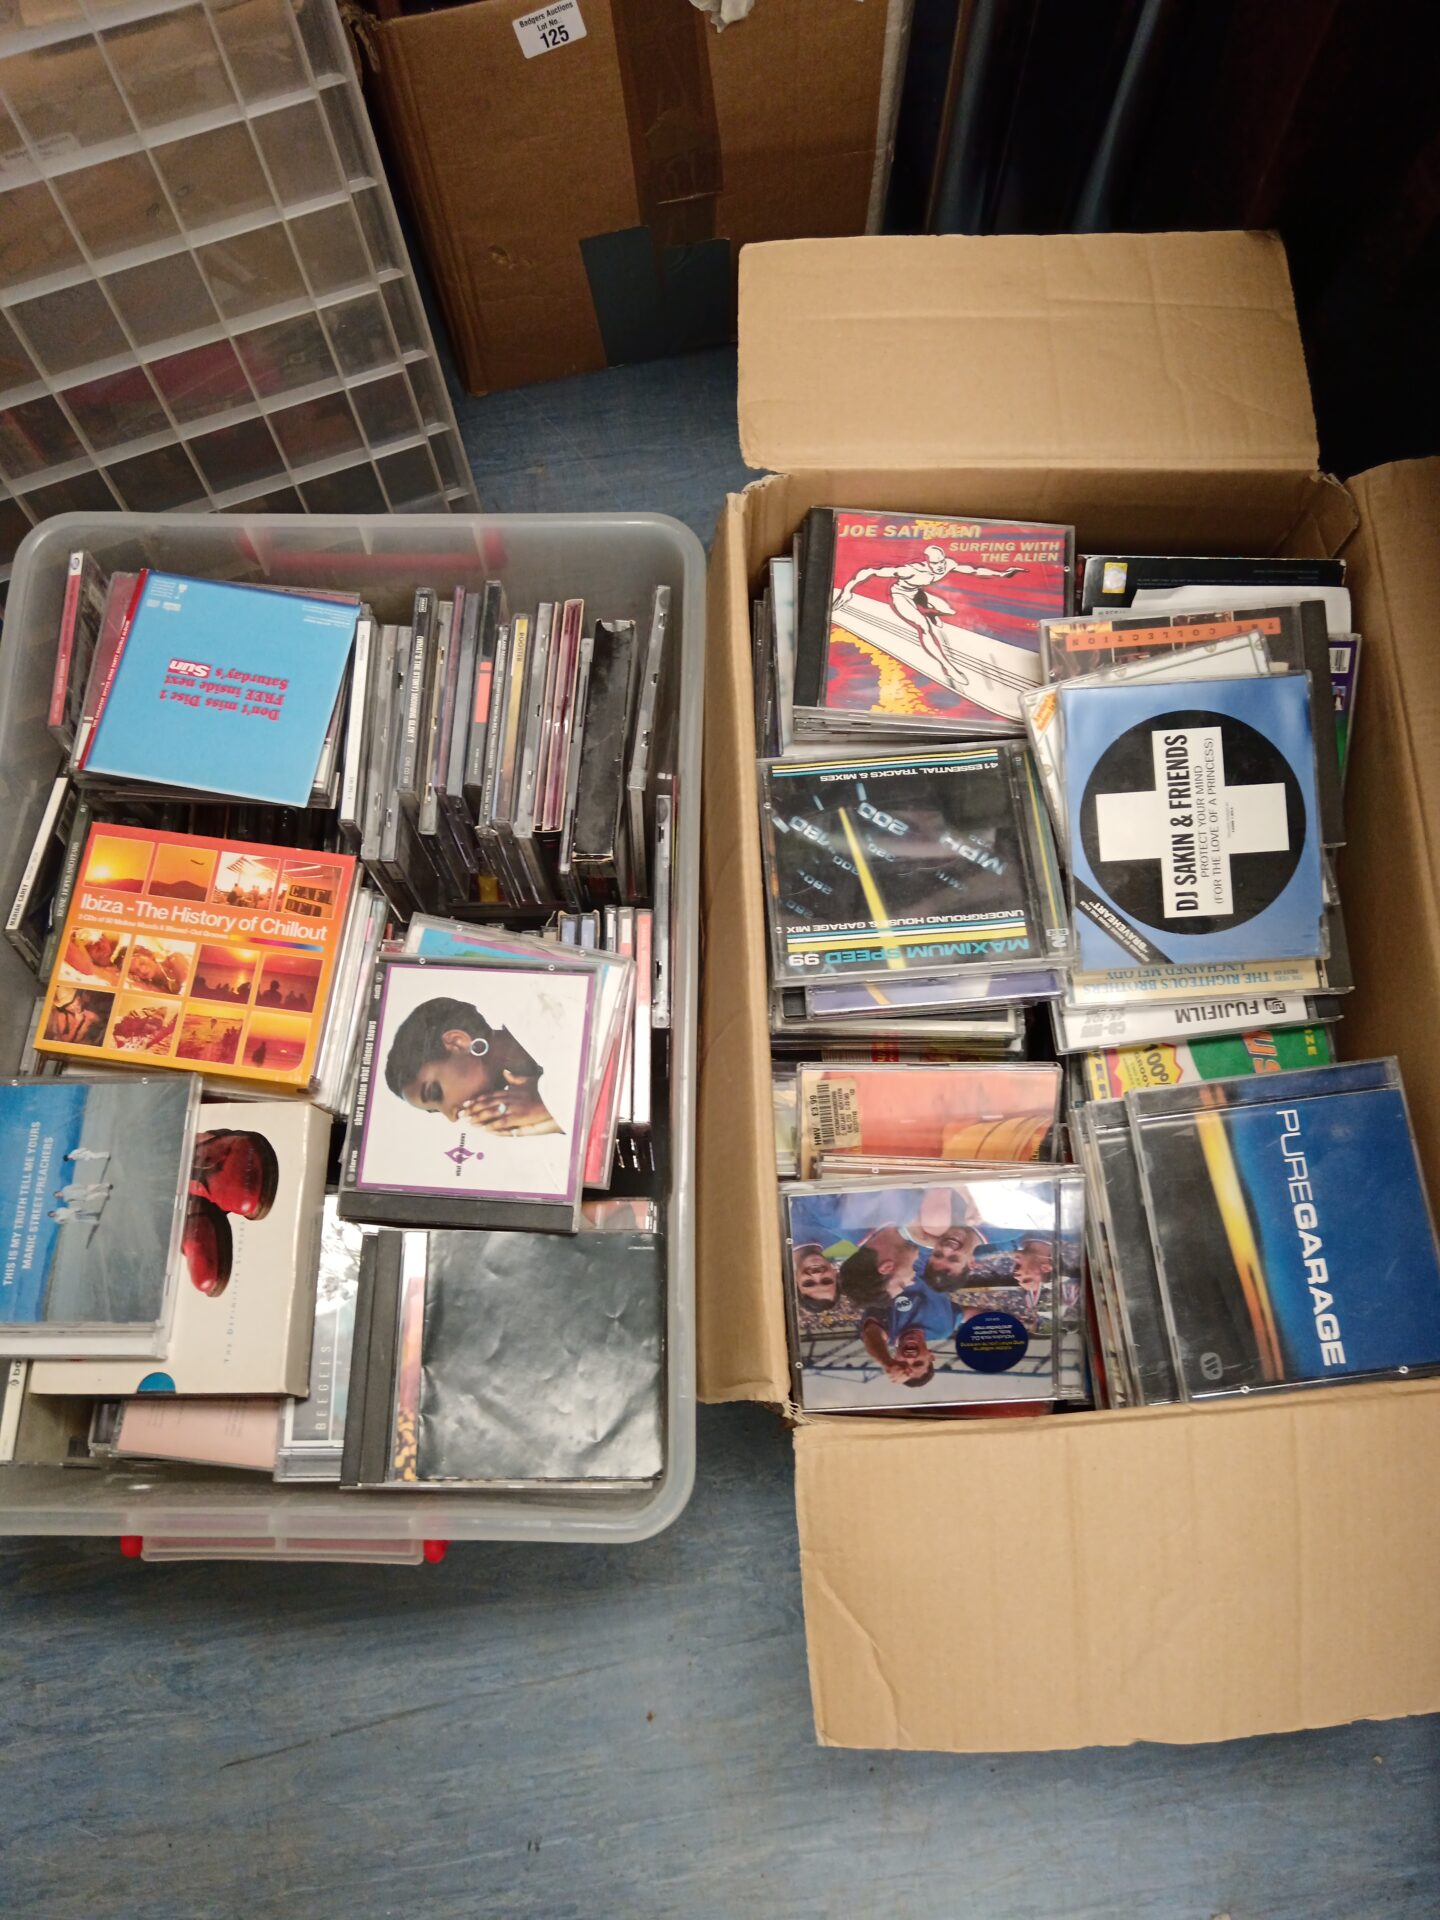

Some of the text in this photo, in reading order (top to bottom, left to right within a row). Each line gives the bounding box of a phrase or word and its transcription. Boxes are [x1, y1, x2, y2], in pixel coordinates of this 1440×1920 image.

[519, 2, 573, 28] Badgers Auctions
[537, 24, 548, 32] Lot
[540, 25, 569, 48] 125
[838, 525, 982, 539] JOE SATRIANI
[949, 542, 1060, 552] SURFING WITH
[981, 552, 1058, 562] THE ALIEN
[516, 632, 525, 662] ROOSTER
[1071, 628, 1216, 646] COLLECTION
[111, 654, 119, 667] PARTY
[414, 661, 422, 671] THE
[169, 660, 289, 690] Saturday's Sun
[164, 675, 285, 706] FREE inside next
[169, 690, 201, 707] Disc
[204, 698, 237, 711] miss
[241, 704, 280, 721] Don't
[820, 773, 857, 781] MIXES
[869, 768, 918, 778] TRACKS
[920, 763, 983, 774] ESSENTIAL
[856, 801, 909, 836] 200
[1164, 734, 1199, 911] DJ SAKIN & FRIENDS
[1194, 765, 1210, 878] PROTECT YOUR MIND
[1204, 738, 1224, 904] (FOR THE LOVE OF A PRINCESS)
[61, 875, 73, 895] HOPES
[9, 884, 29, 926] MARIAH CAREY
[57, 897, 67, 917] KEANE
[926, 909, 1024, 923] UNDERGROUND
[79, 893, 123, 915] Ibiza
[171, 906, 237, 932] History
[239, 917, 257, 931] of
[260, 918, 328, 941] Chillout
[812, 921, 866, 931] GARAGE
[787, 924, 811, 933] MIX
[787, 938, 1029, 966] MAXIMUM SPEED 99
[1083, 971, 1271, 993] THE RIGHTEOUS BROTHERS
[1174, 1000, 1259, 1024] FUJIFILM
[355, 1021, 377, 1126] shara nelson what silence knows
[810, 1095, 822, 1145] HMV £3.99
[3, 1121, 41, 1286] THIS IS MY TRUTH TELL ME YOURS
[22, 1136, 54, 1269] MANIC STREET PREACHERS
[1276, 1109, 1346, 1367] PUREGARAGE
